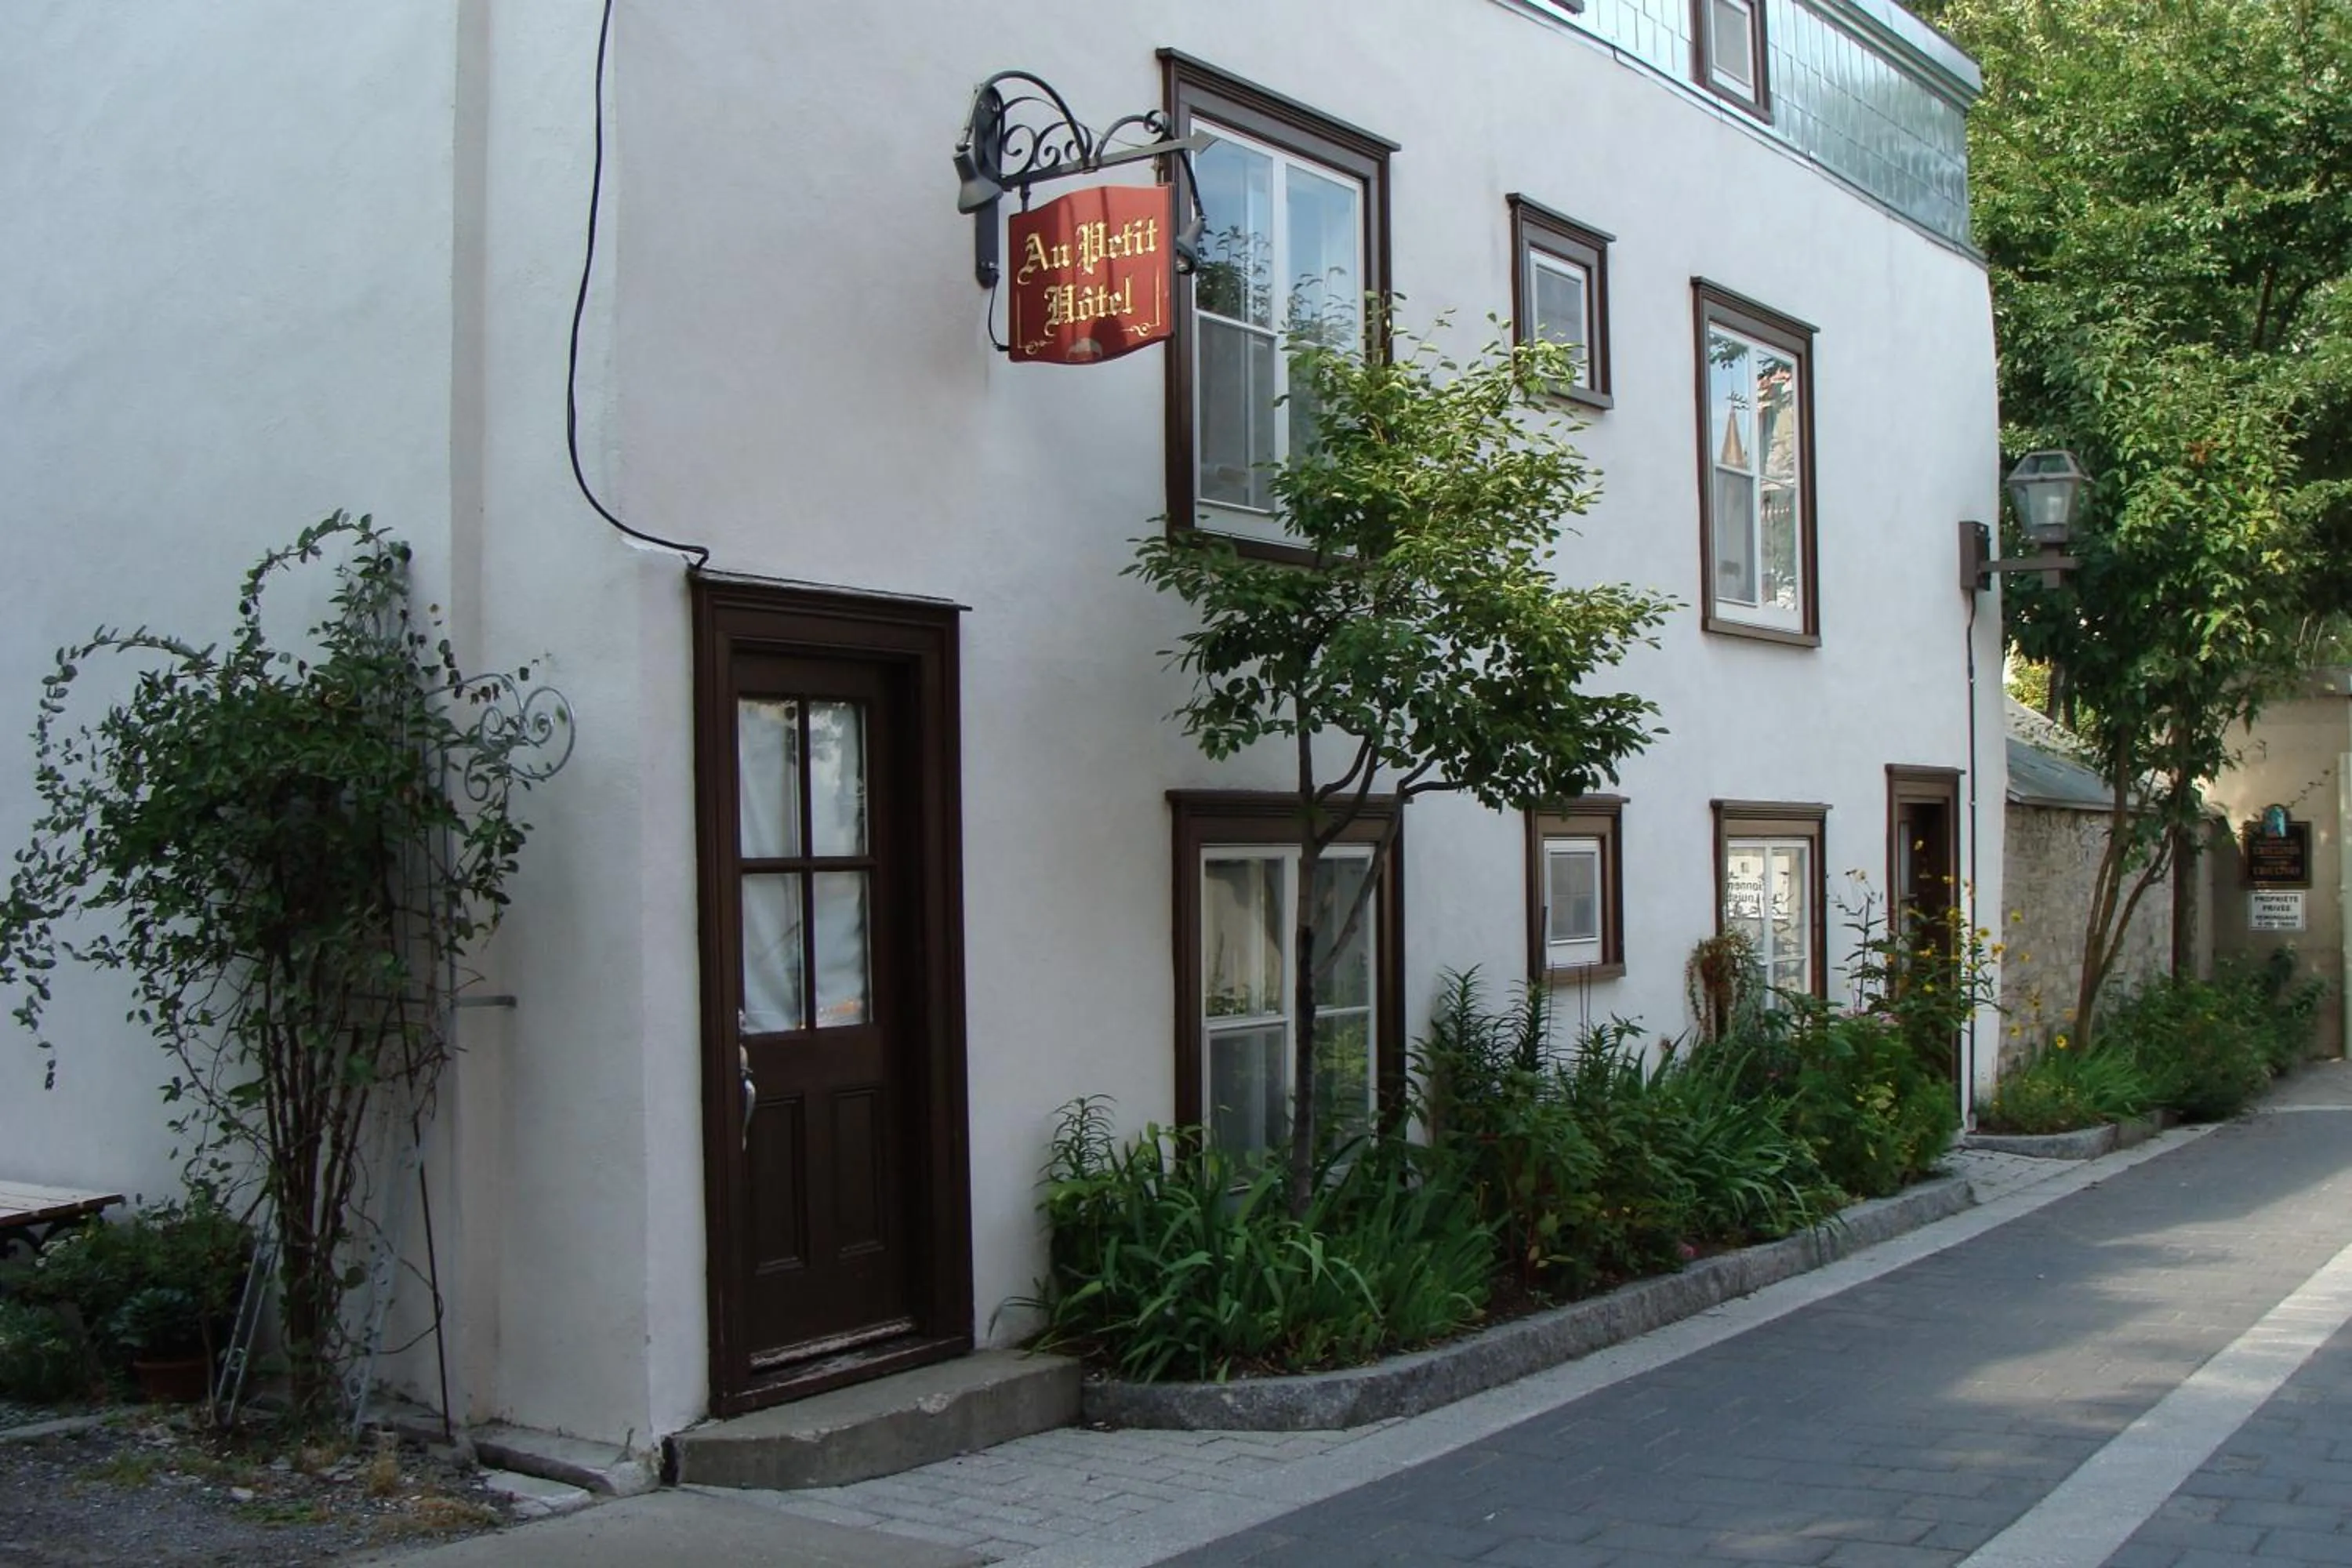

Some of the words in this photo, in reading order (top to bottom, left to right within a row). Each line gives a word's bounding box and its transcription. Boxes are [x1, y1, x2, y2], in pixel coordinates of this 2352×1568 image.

[1017, 233, 1072, 285] Au
[1076, 216, 1159, 275] Petit
[1044, 277, 1134, 336] Hôtel
